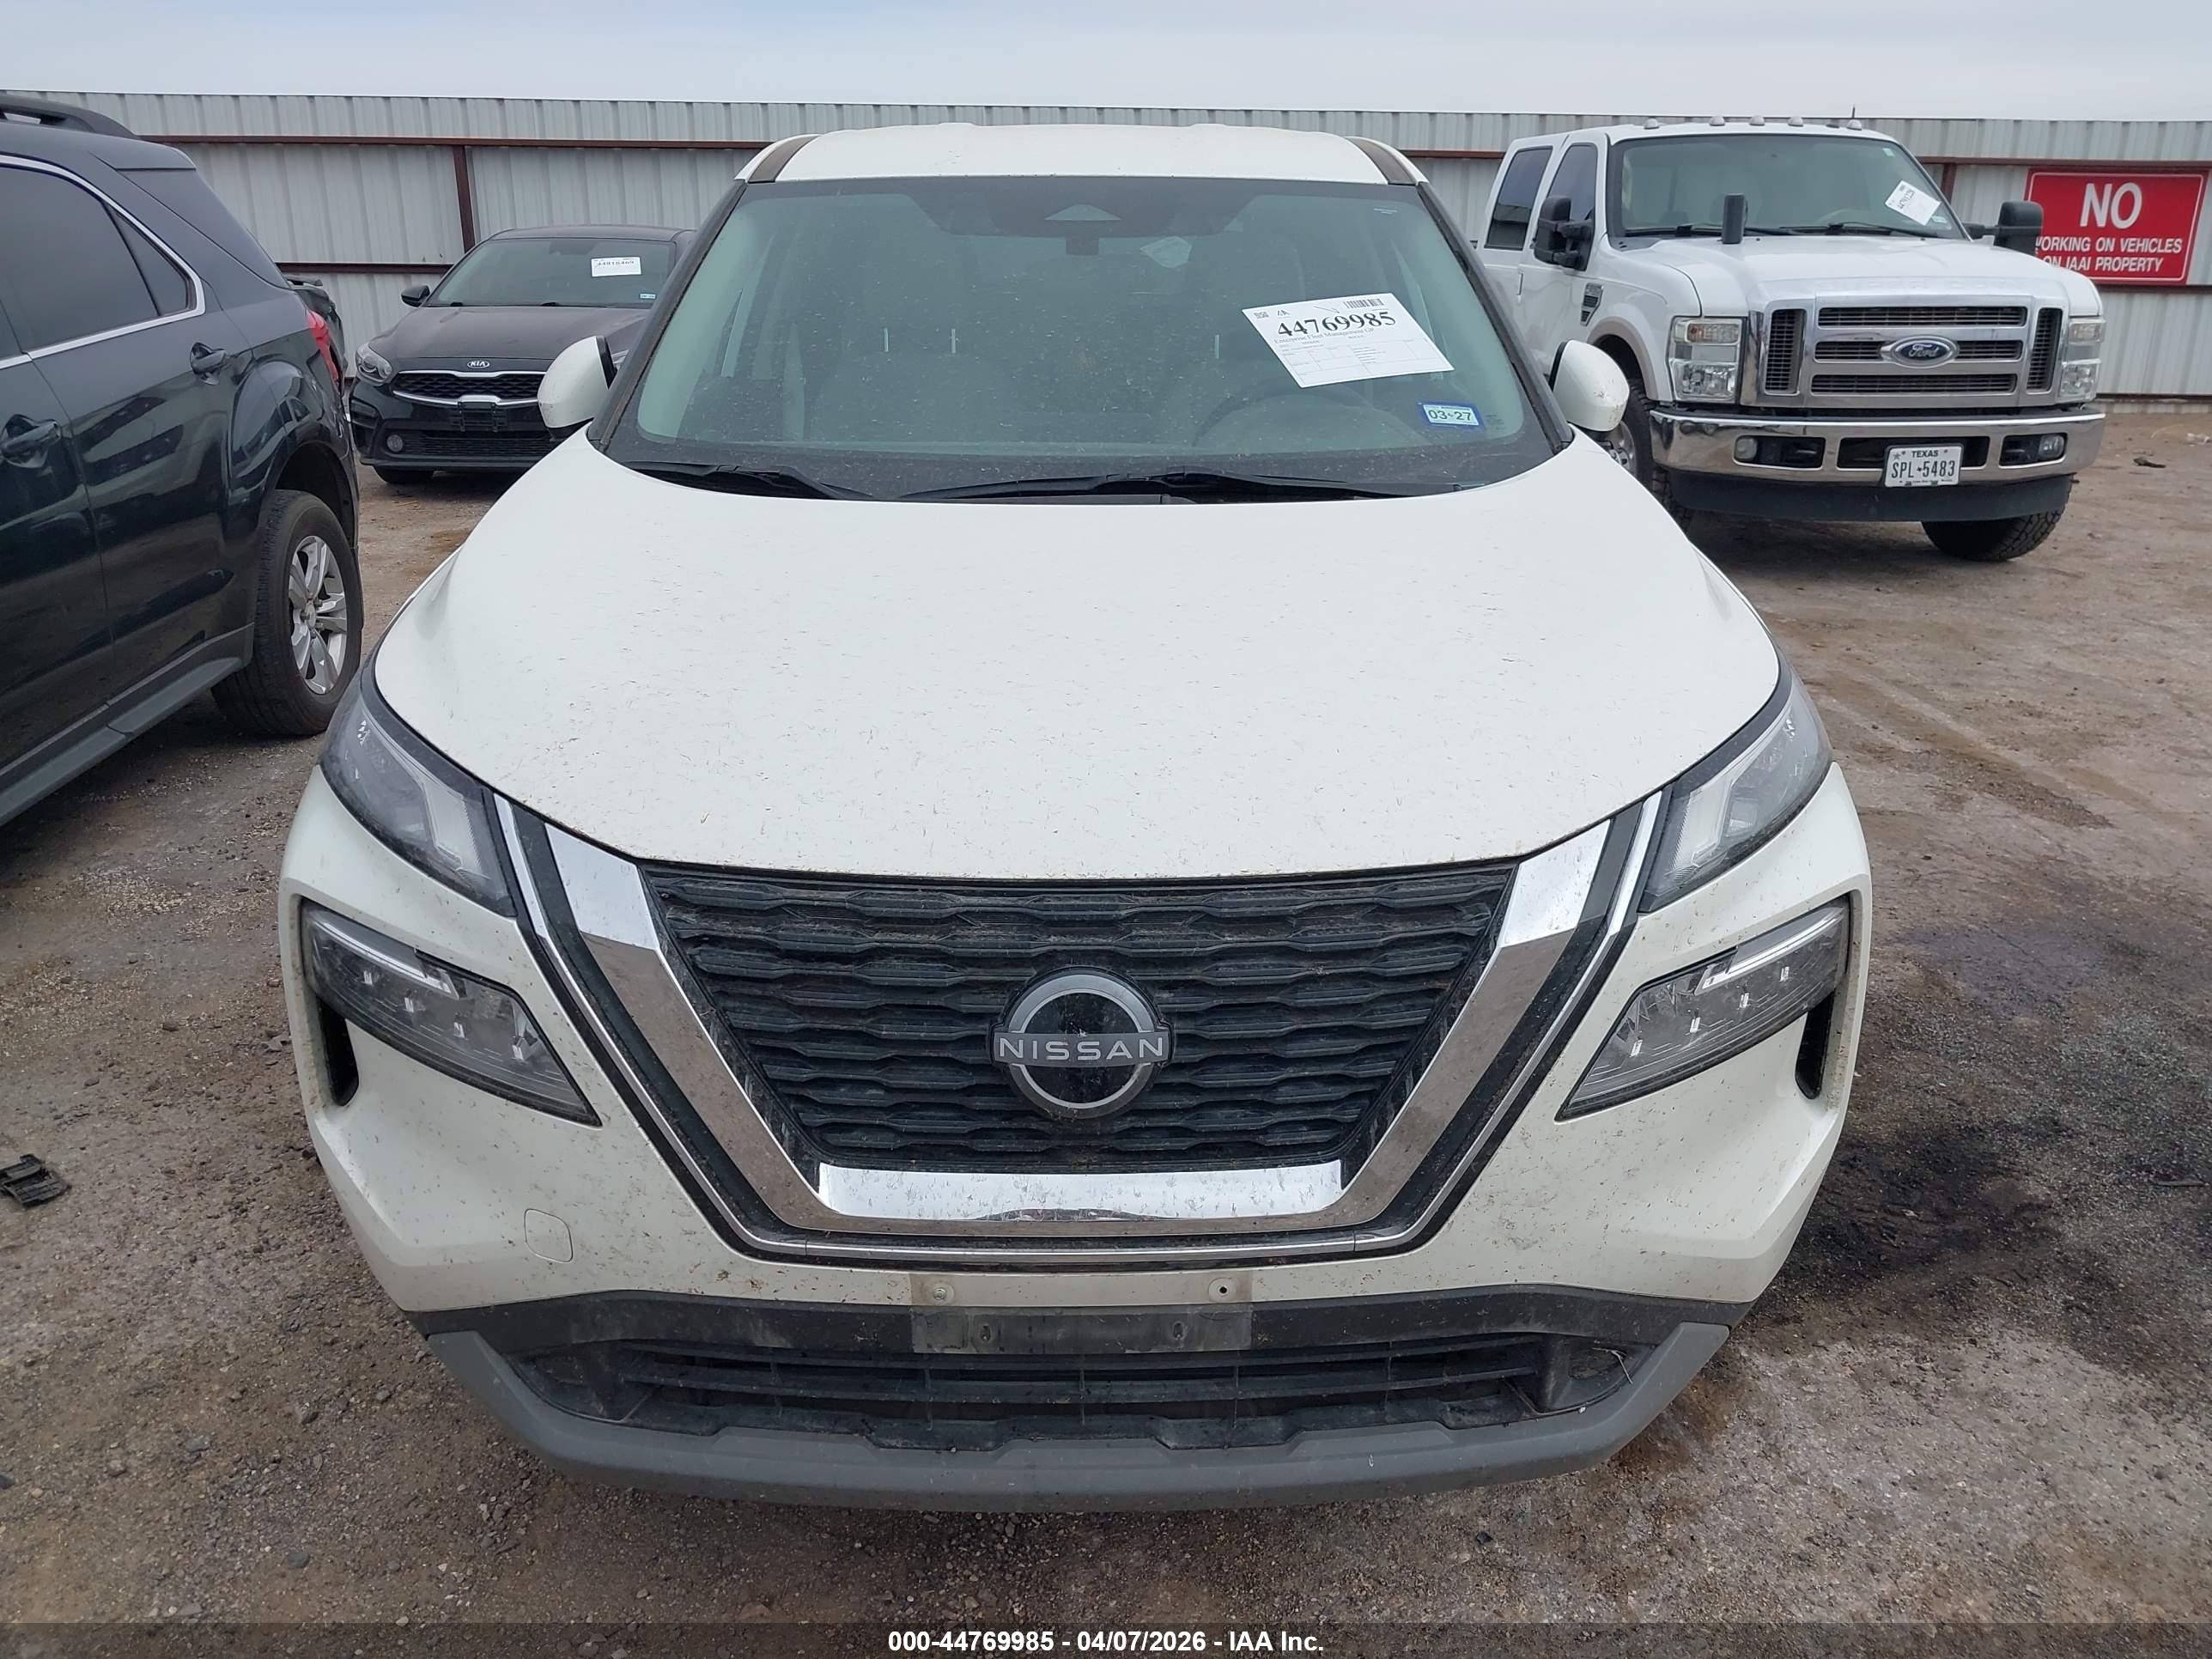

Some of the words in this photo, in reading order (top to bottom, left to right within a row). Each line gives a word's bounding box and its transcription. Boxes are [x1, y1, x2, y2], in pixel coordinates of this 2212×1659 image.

[2080, 182, 2142, 229] NO
[2095, 237, 2116, 252] ON
[2120, 238, 2183, 253] VEHICLES
[2095, 258, 2164, 272] PROPERTY
[1278, 311, 1396, 337] 44769985
[1908, 343, 1940, 357] Ford
[1911, 450, 1939, 459] TEXAS
[1000, 1036, 1163, 1060] NISSAN
